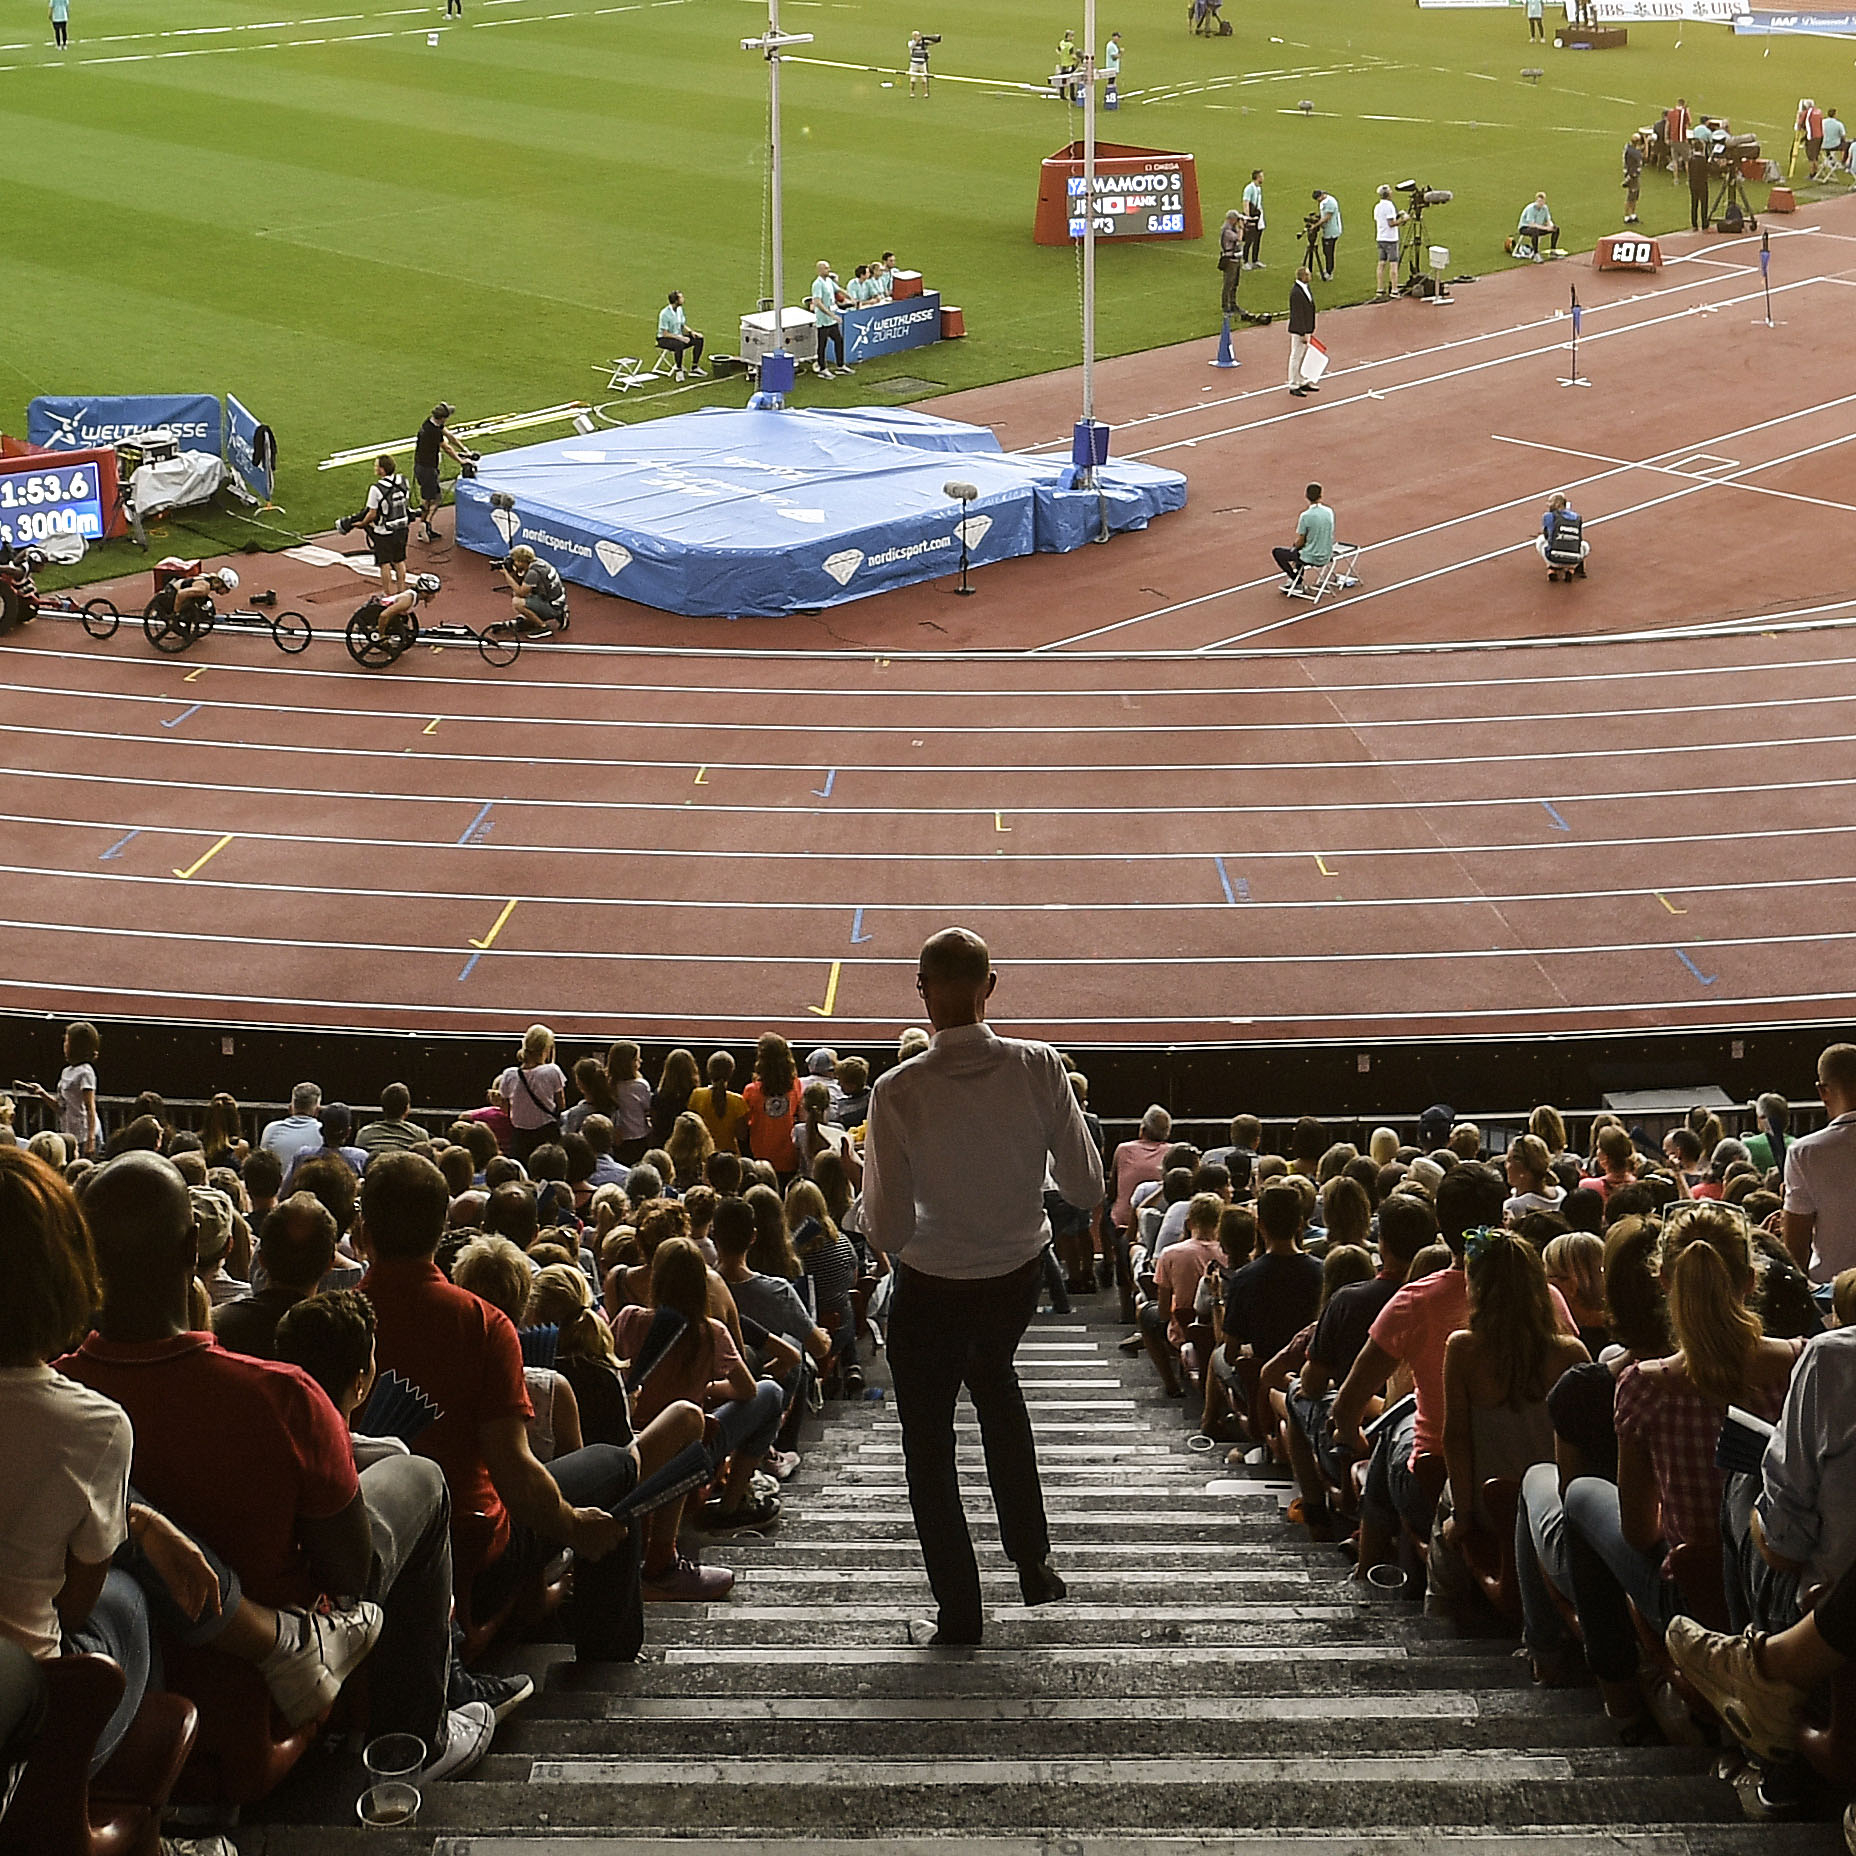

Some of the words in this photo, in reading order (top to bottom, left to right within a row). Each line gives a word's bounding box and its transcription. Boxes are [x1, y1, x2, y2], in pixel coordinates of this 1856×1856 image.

[1652, 2, 1684, 17] UBS
[1711, 2, 1742, 15] UBS
[1170, 173, 1181, 191] S
[1161, 194, 1181, 211] 11
[873, 308, 934, 331] WELTKLASSE
[0, 471, 90, 509] 1:53.6
[17, 508, 99, 542] 3000m
[522, 527, 593, 559] nordicsport.com
[868, 535, 951, 567] nordicsport.com
